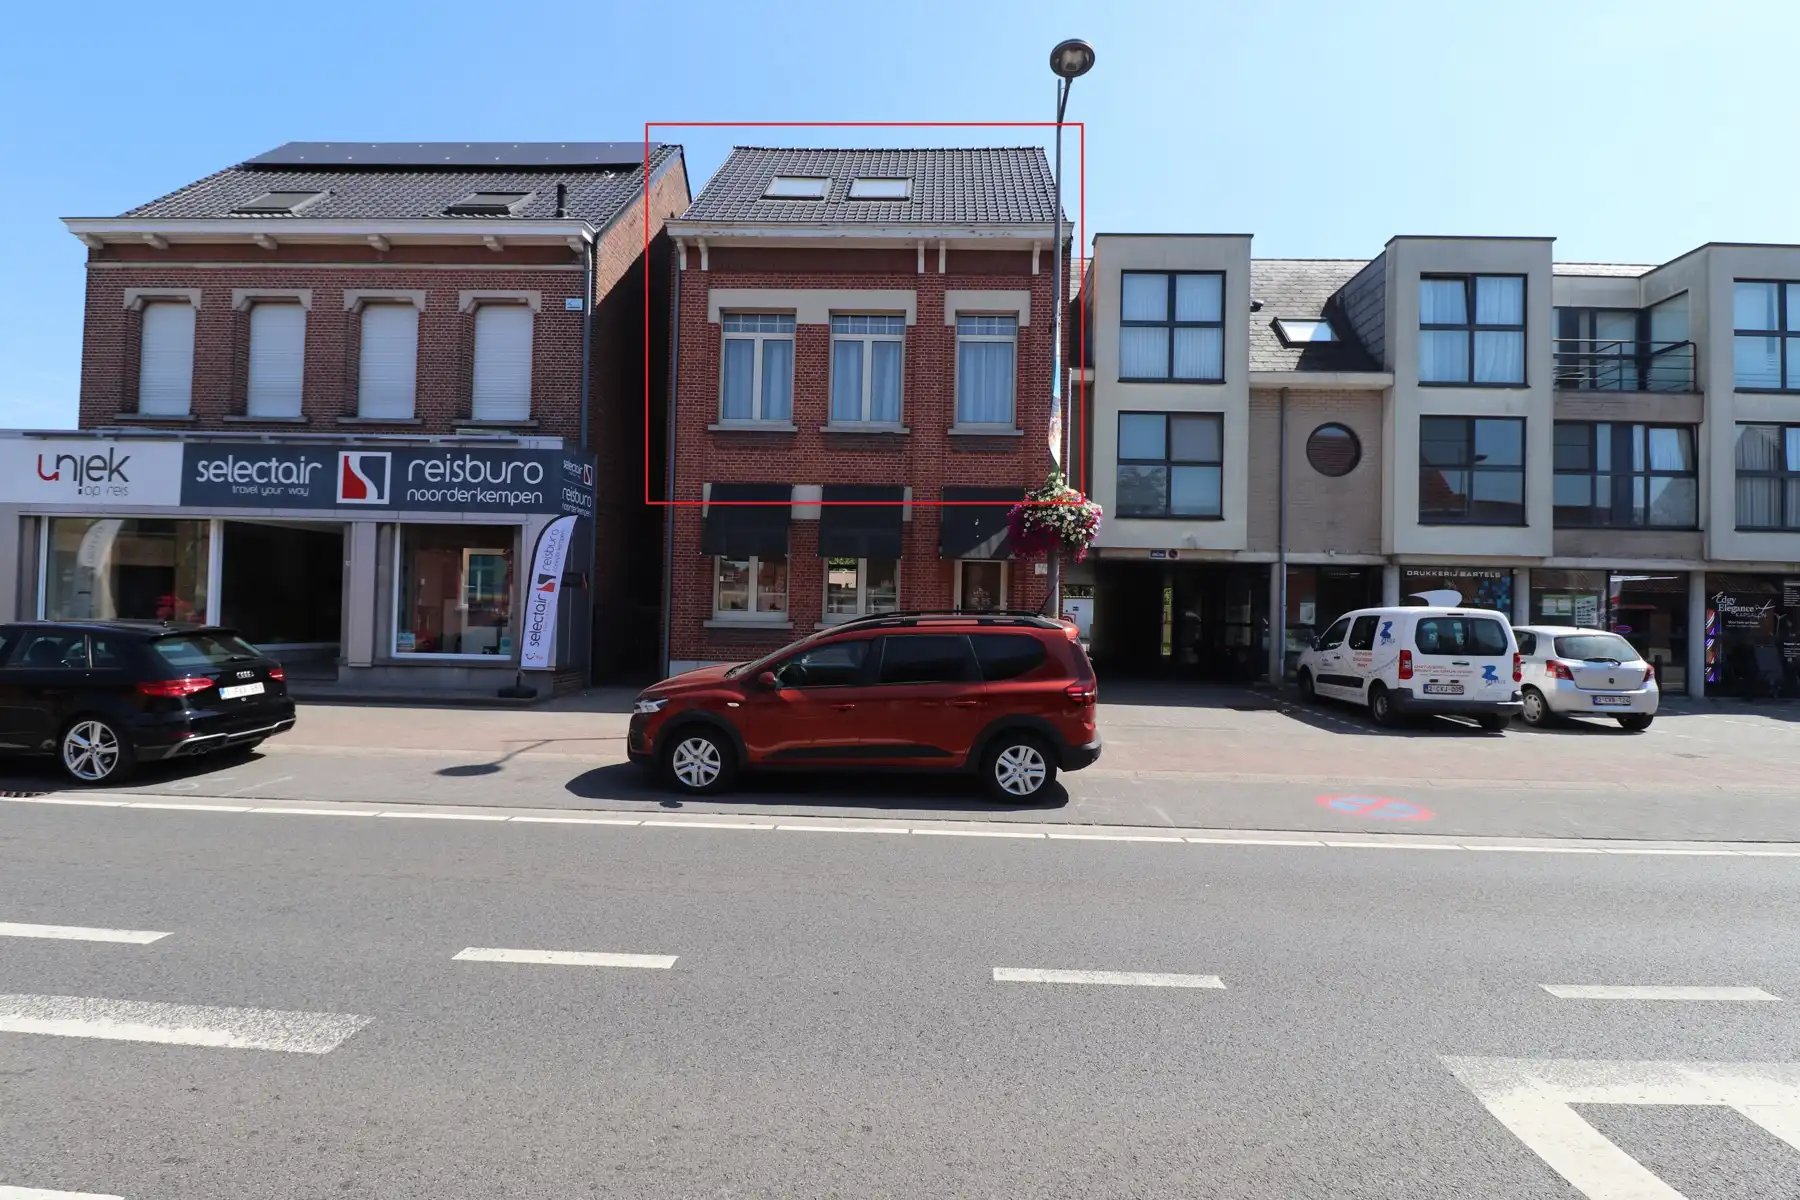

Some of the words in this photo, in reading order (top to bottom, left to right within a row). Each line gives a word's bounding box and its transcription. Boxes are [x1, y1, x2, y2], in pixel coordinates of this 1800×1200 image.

[196, 454, 323, 484] selectair
[408, 454, 544, 484] reisburo
[84, 485, 100, 497] op
[106, 485, 129, 497] reis
[232, 485, 258, 494] travel
[261, 486, 284, 496] your
[288, 487, 309, 497] way
[407, 487, 543, 506] noorderkempen
[562, 486, 592, 508] reisburo
[542, 528, 559, 572] reisburo
[1460, 570, 1501, 578] BARTELS
[1712, 591, 1737, 606] Edgy
[1718, 603, 1755, 614] Elegance
[529, 593, 547, 647] selectair
